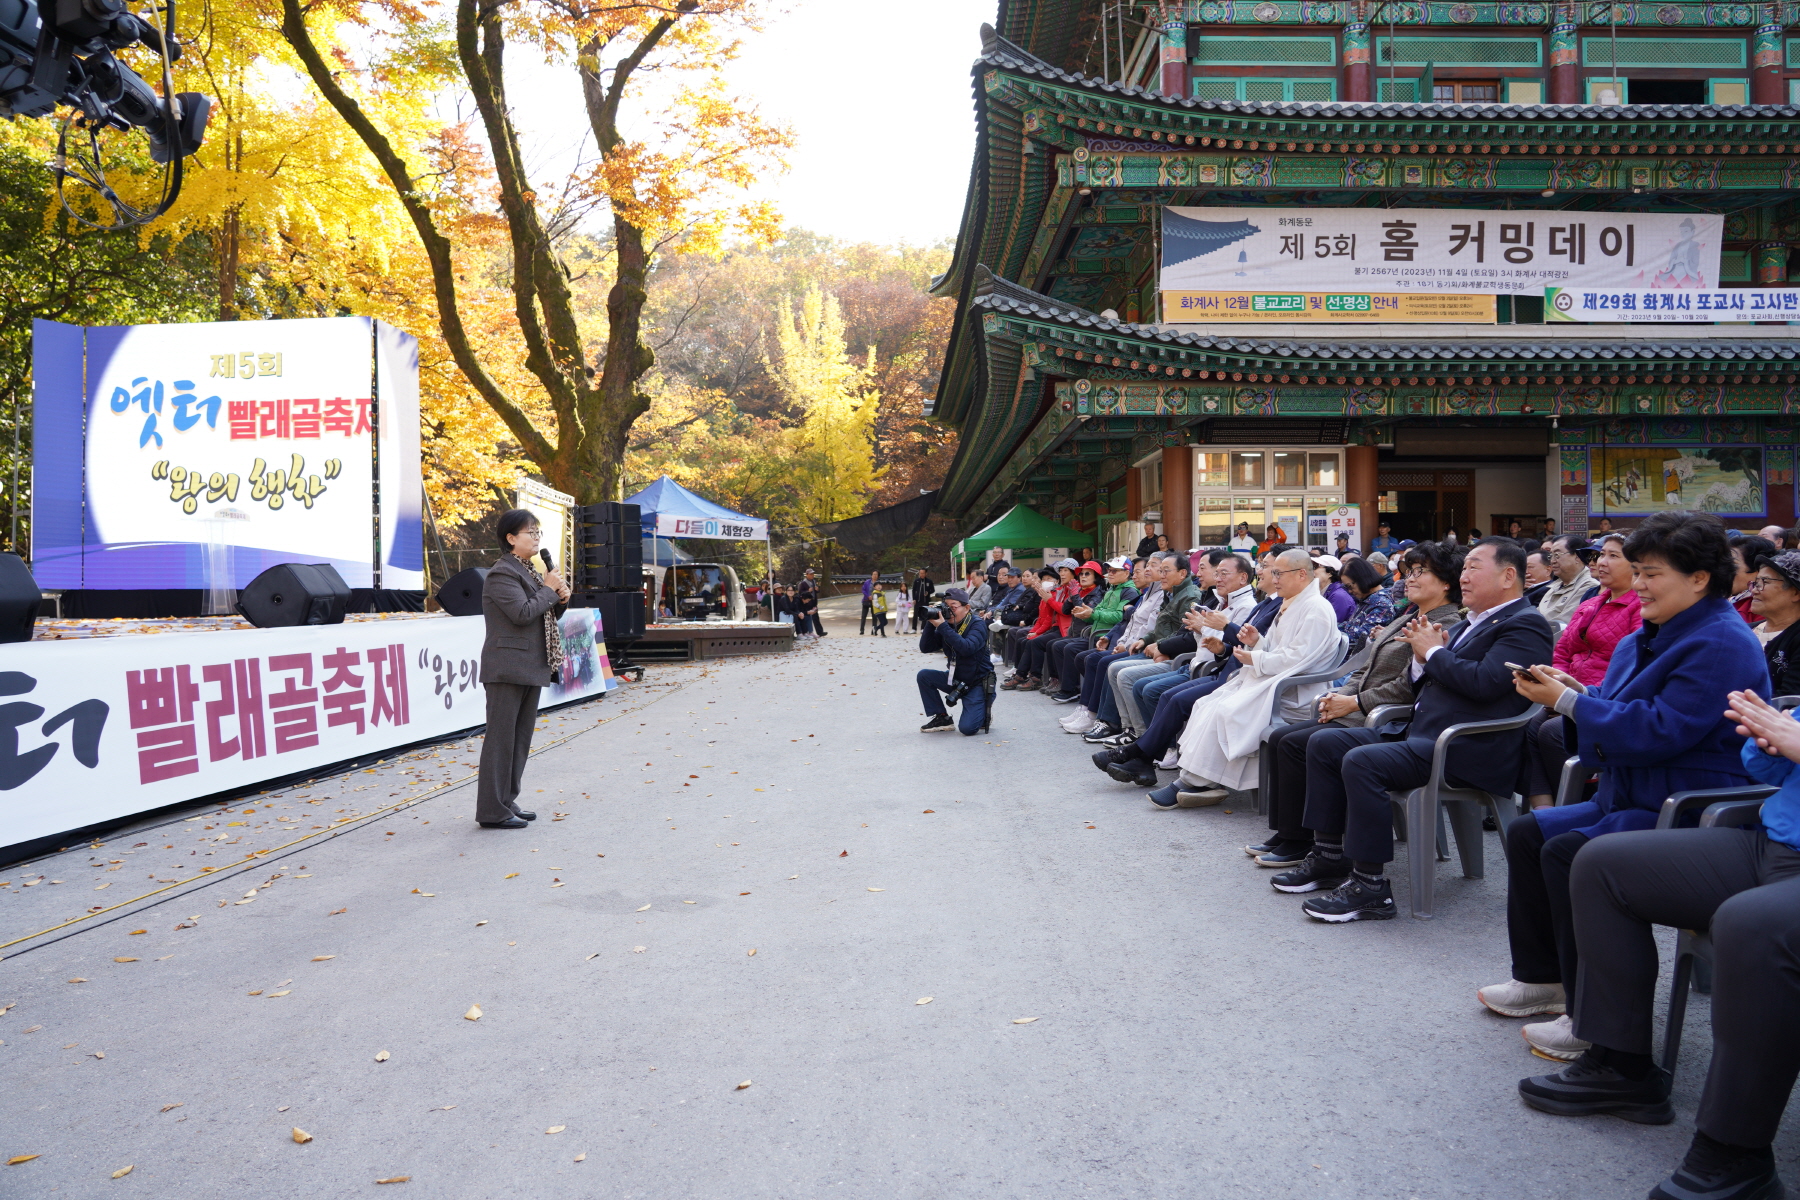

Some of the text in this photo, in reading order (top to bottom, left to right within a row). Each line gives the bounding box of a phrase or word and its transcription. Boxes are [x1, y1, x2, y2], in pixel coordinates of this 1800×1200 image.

[1278, 217, 1313, 227] 화계동문
[1354, 267, 1369, 276] 불기
[1371, 267, 1399, 276] 2567년
[1401, 267, 1436, 277] (2023년)
[1438, 268, 1453, 277] 11월
[1455, 268, 1468, 277] 4일
[1470, 268, 1498, 278] (토요일)
[1501, 269, 1513, 278] 3시
[1515, 270, 1537, 279] 화계사
[1180, 296, 1220, 309] 화계사
[1223, 296, 1249, 309] 12월
[1253, 296, 1305, 309] 불교교리
[1310, 296, 1322, 309] 및
[1372, 296, 1399, 309] 안내
[1583, 293, 1799, 311] 제29회 화계사 포교사 고시반
[209, 351, 283, 379] 제5회
[675, 519, 753, 538] 다듬이 체험장
[126, 643, 410, 786] 빨래골축제
